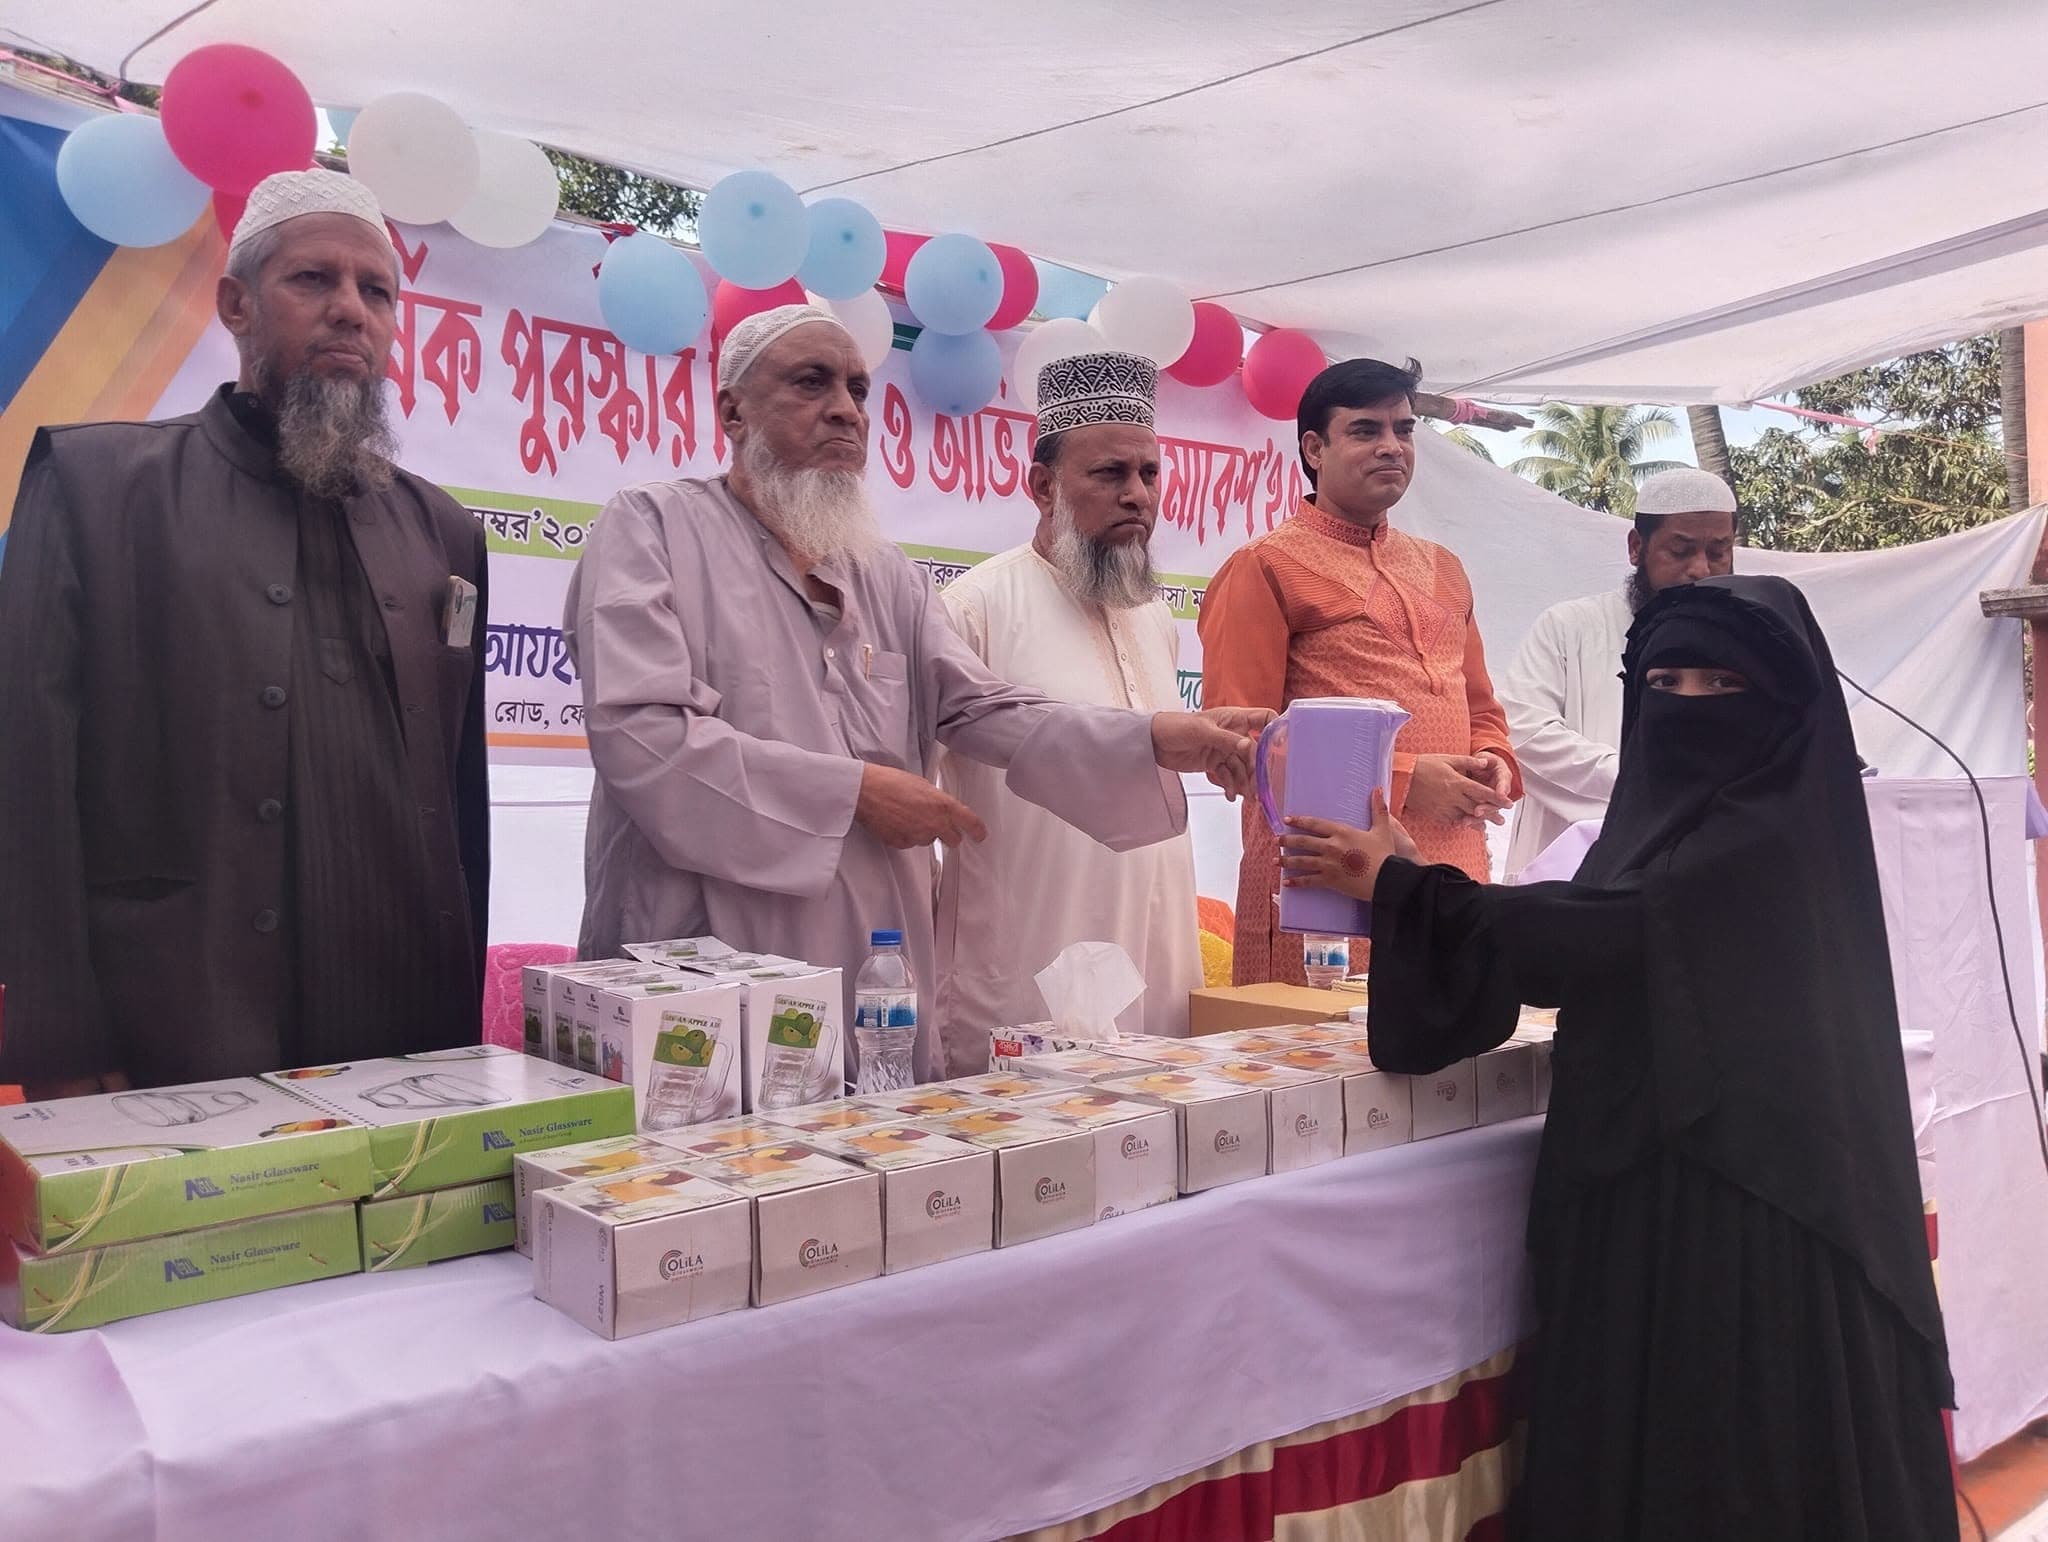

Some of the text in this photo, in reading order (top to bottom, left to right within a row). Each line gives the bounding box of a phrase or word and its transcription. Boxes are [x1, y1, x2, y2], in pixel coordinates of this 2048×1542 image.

[519, 1125, 545, 1138] Nasir
[546, 1118, 593, 1132] Glassware
[230, 1172, 261, 1185] Nasir
[264, 1162, 320, 1179] Glassware
[210, 1252, 241, 1266] Nasir
[244, 1241, 301, 1259] Glassware
